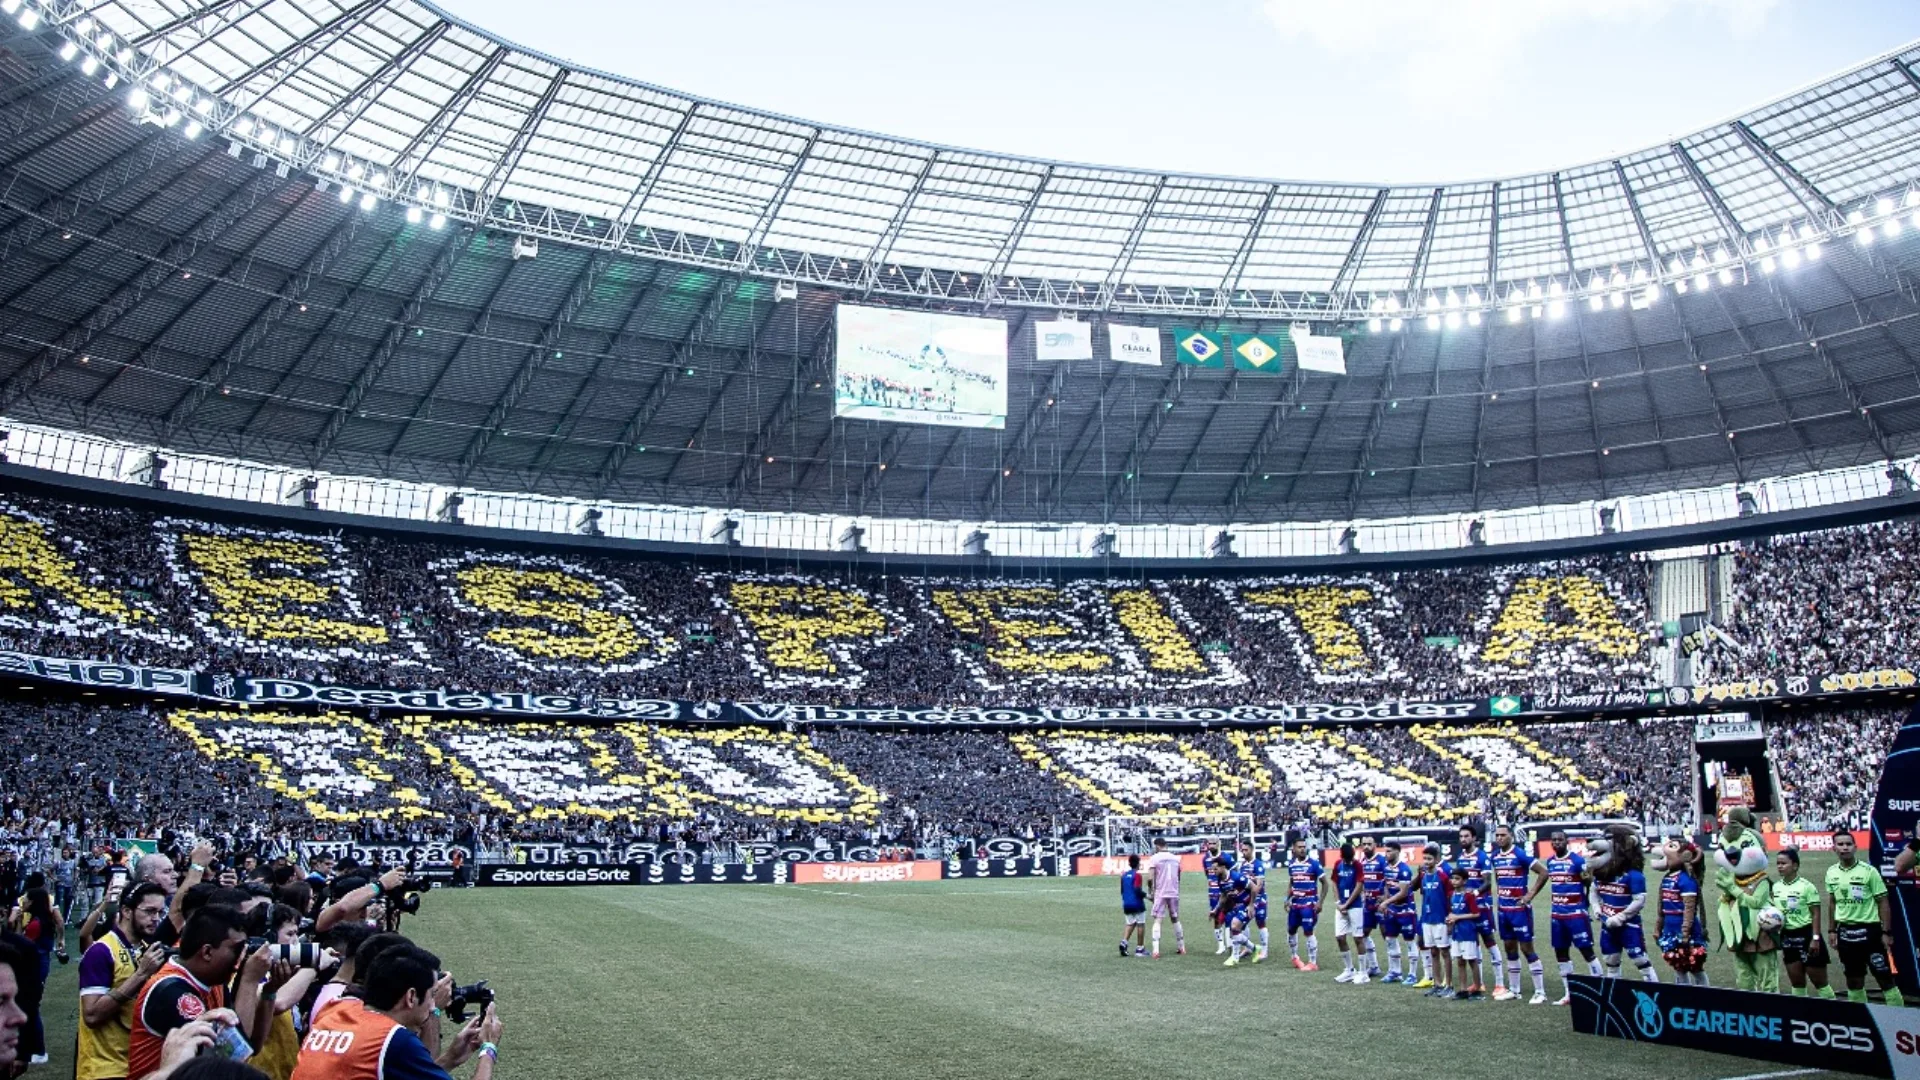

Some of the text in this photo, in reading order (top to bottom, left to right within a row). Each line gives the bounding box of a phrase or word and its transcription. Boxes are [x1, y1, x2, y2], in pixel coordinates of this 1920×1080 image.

[248, 678, 489, 711] Desde
[1285, 701, 1477, 722] Poder
[1778, 833, 1834, 852] SUPERB
[822, 862, 915, 883] SUPERBET
[1668, 1006, 1875, 1053] CEARENSE 2025
[302, 1029, 355, 1055] FOTO
